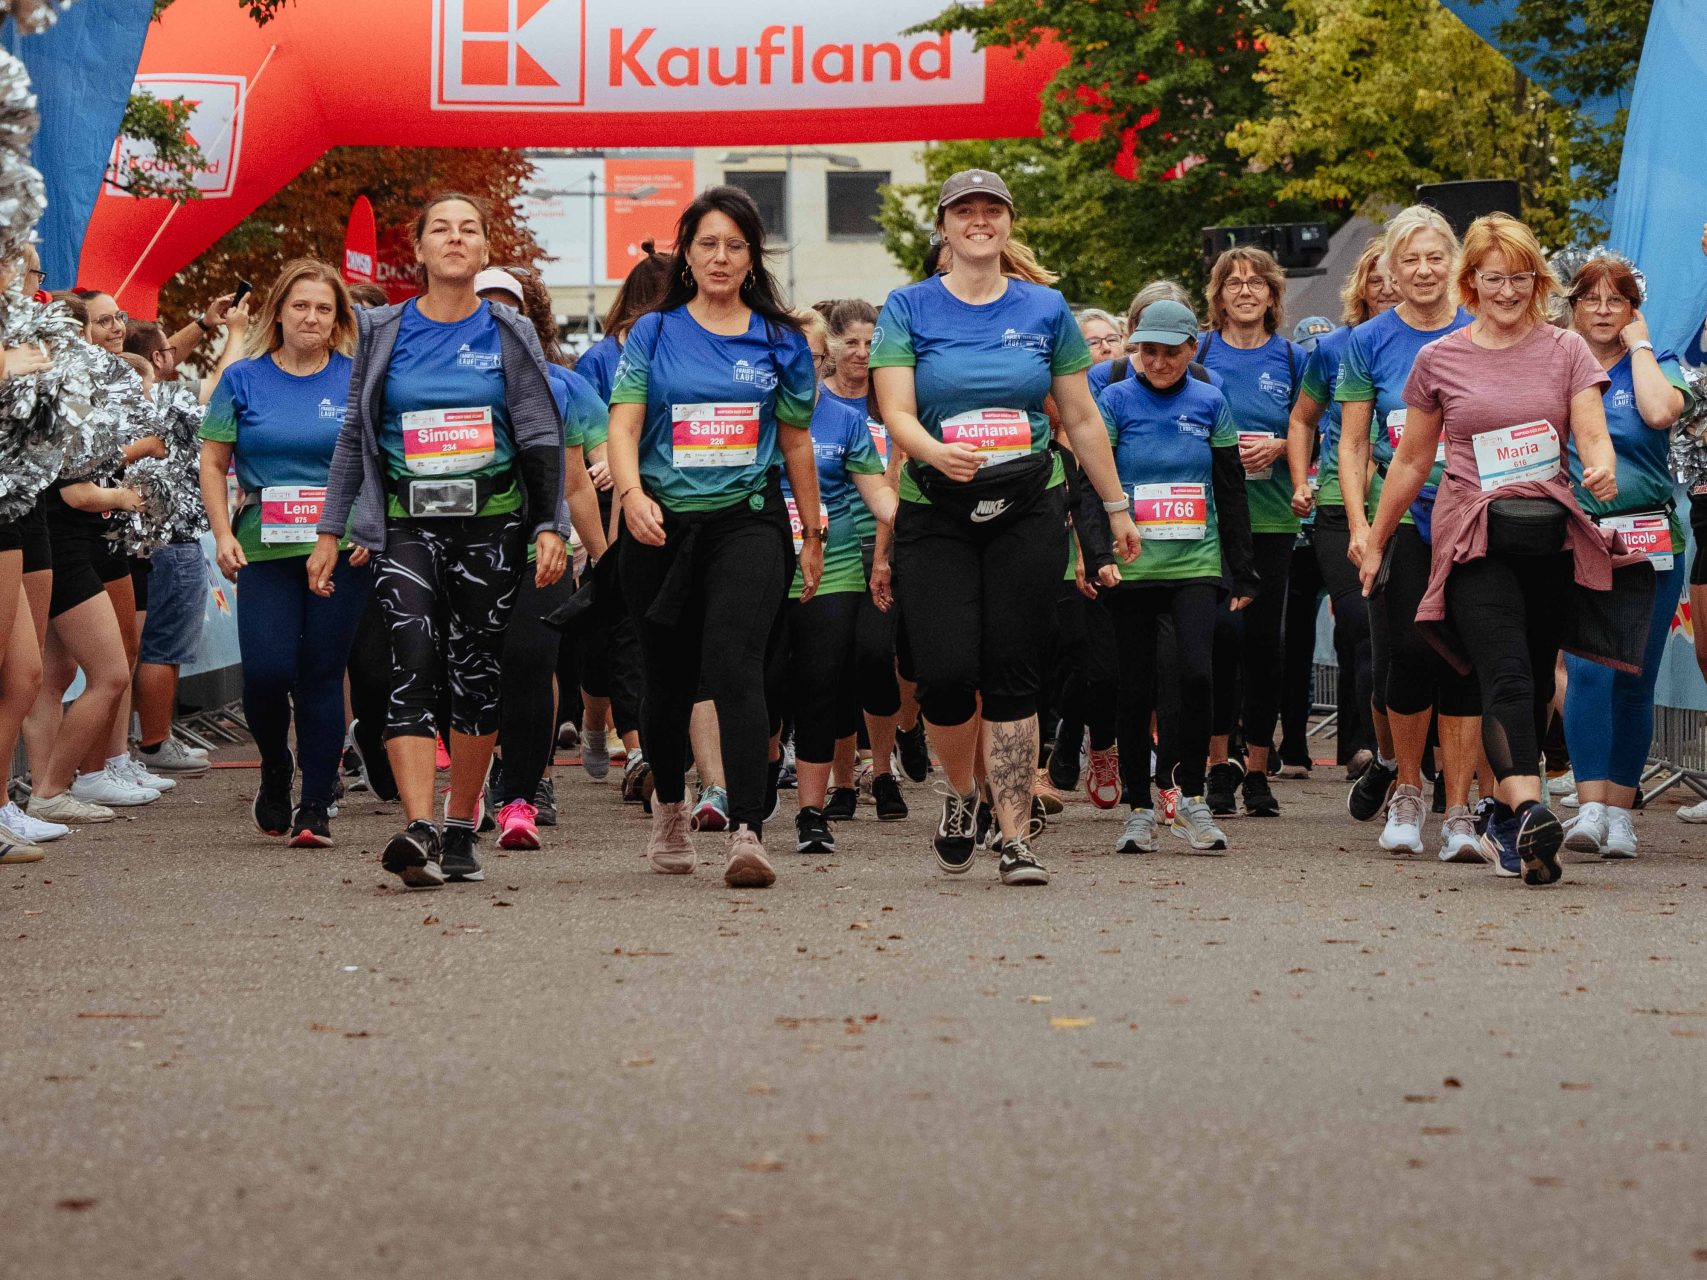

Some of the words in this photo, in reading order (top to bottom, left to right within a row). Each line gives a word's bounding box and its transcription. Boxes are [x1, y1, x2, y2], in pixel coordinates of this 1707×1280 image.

[609, 25, 951, 87] Kaufland
[128, 156, 220, 175] Kauad
[735, 373, 754, 382] LAUF
[1614, 399, 1630, 407] LAUF
[689, 421, 745, 435] Sabine
[956, 424, 1018, 439] Adriana
[418, 428, 479, 444] Simone
[981, 439, 995, 448] 215
[1496, 442, 1540, 461] Maria
[283, 502, 318, 515] Lena
[976, 499, 1006, 515] NIKE
[1152, 501, 1195, 518] 1766
